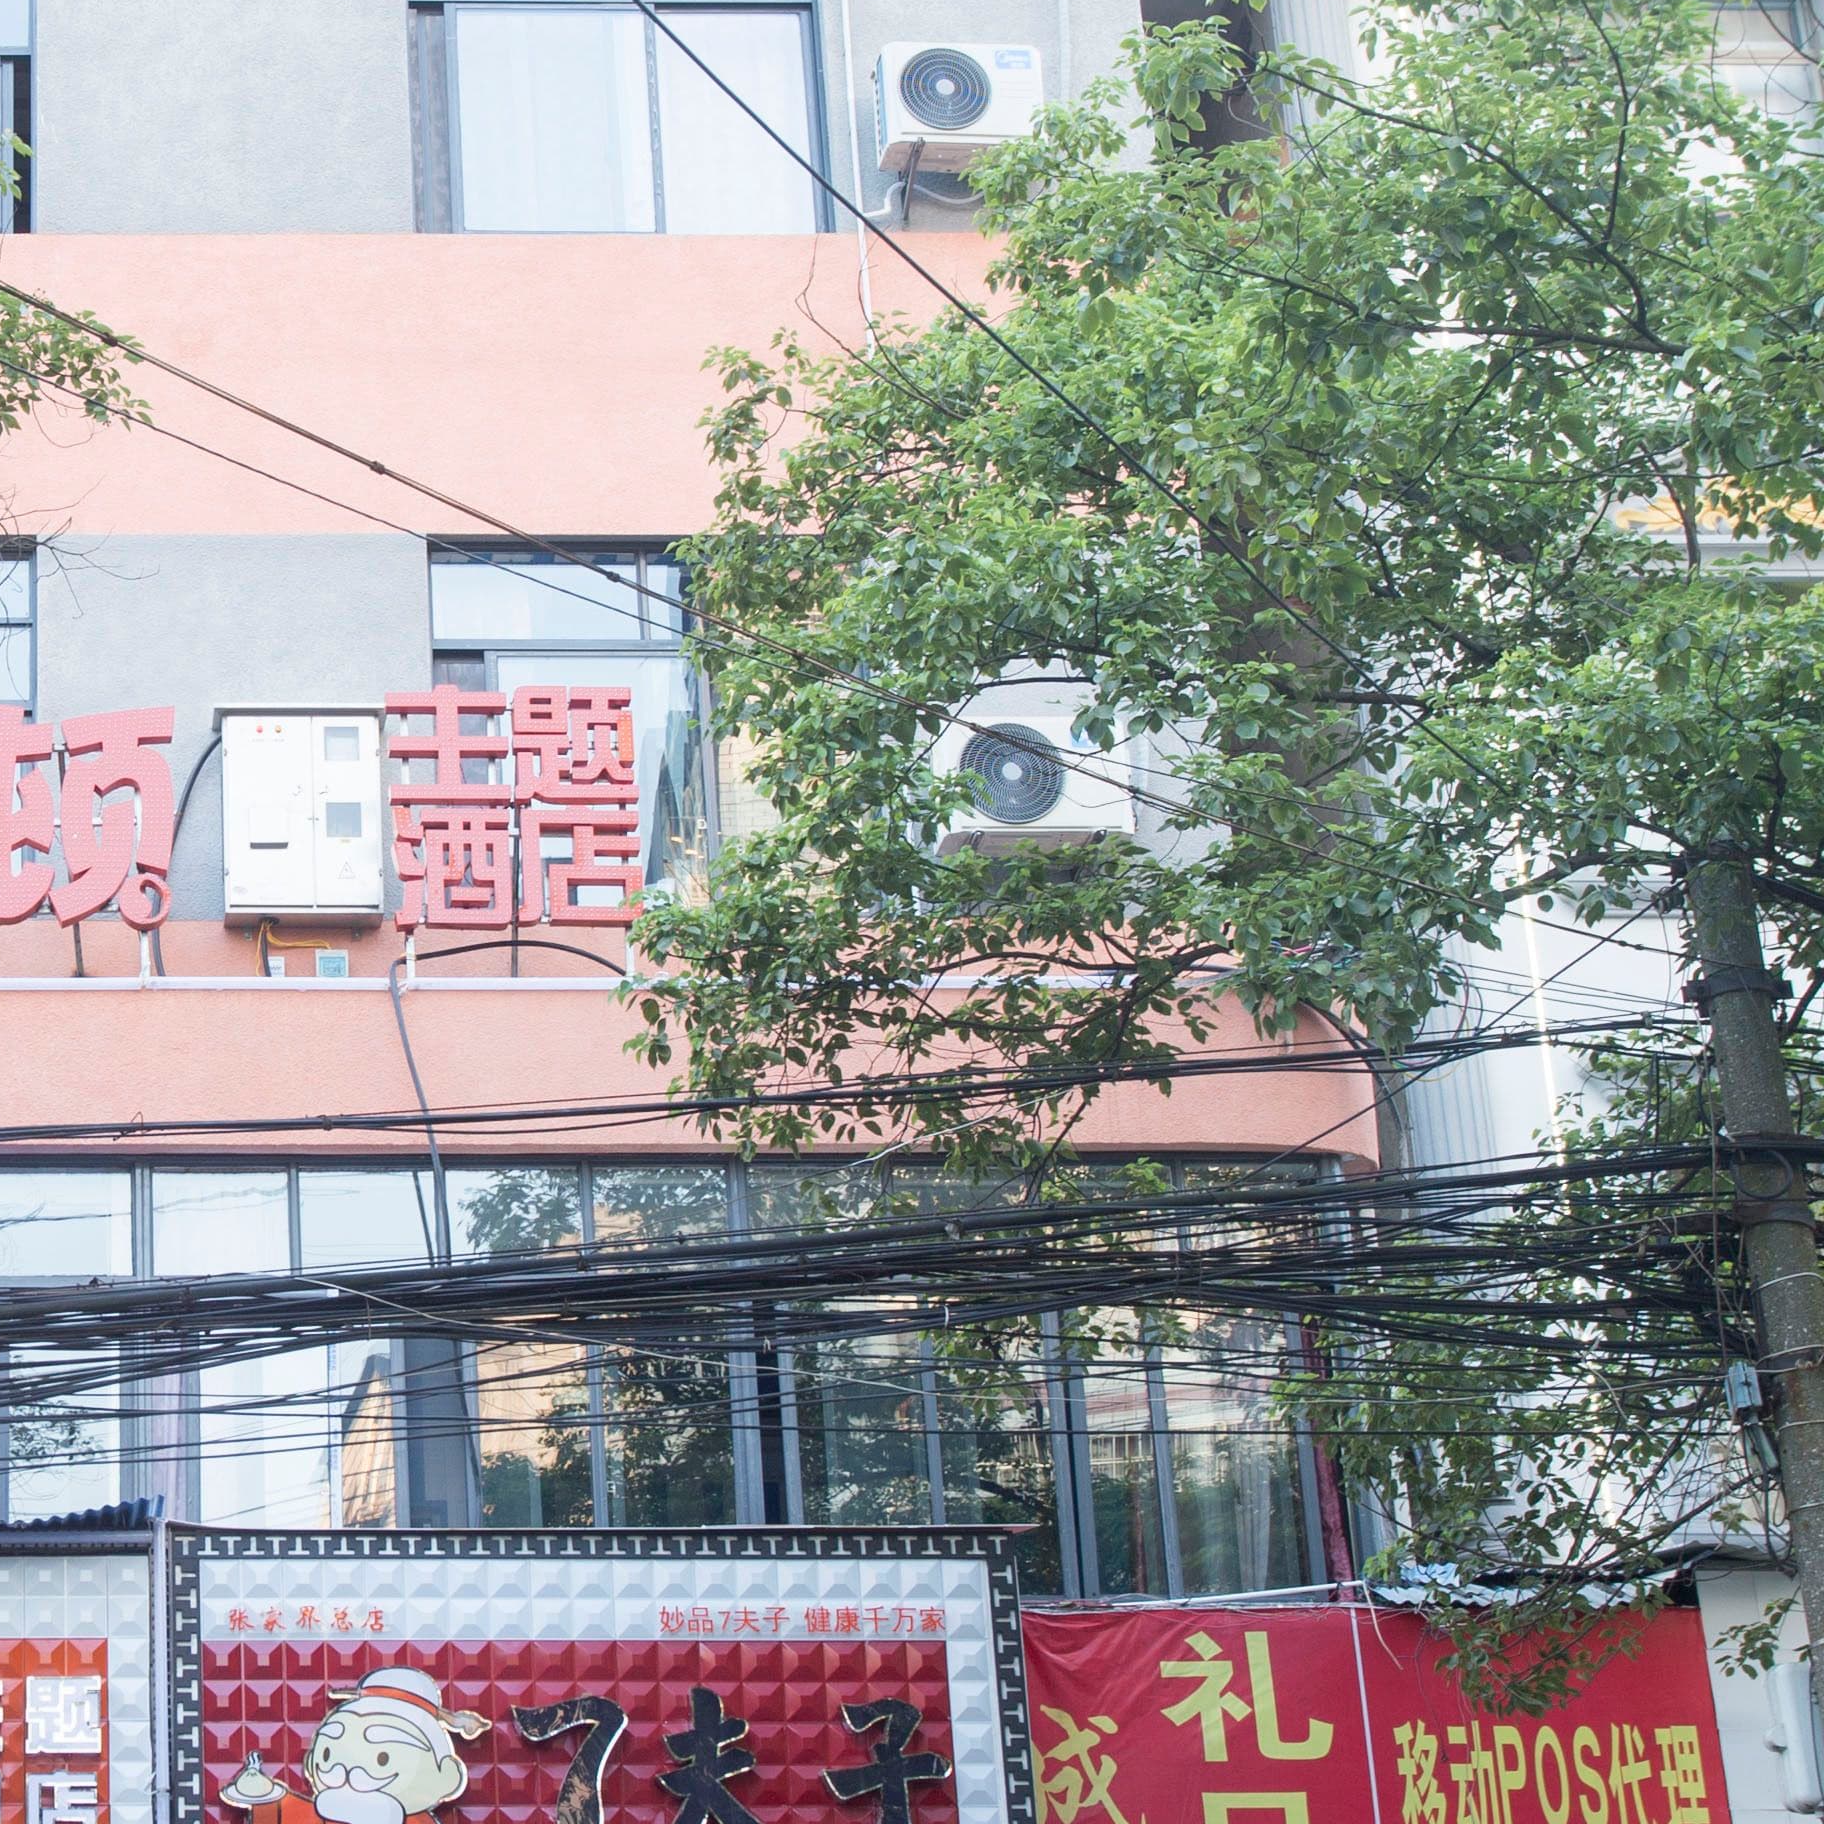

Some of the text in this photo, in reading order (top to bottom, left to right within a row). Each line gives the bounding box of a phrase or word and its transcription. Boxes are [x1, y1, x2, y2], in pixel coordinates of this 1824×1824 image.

[387, 684, 638, 804] 主题
[392, 802, 645, 932] 酒店
[228, 1606, 388, 1634] 张家界总店
[659, 1604, 947, 1634] 妙品7夫子 健康千万家
